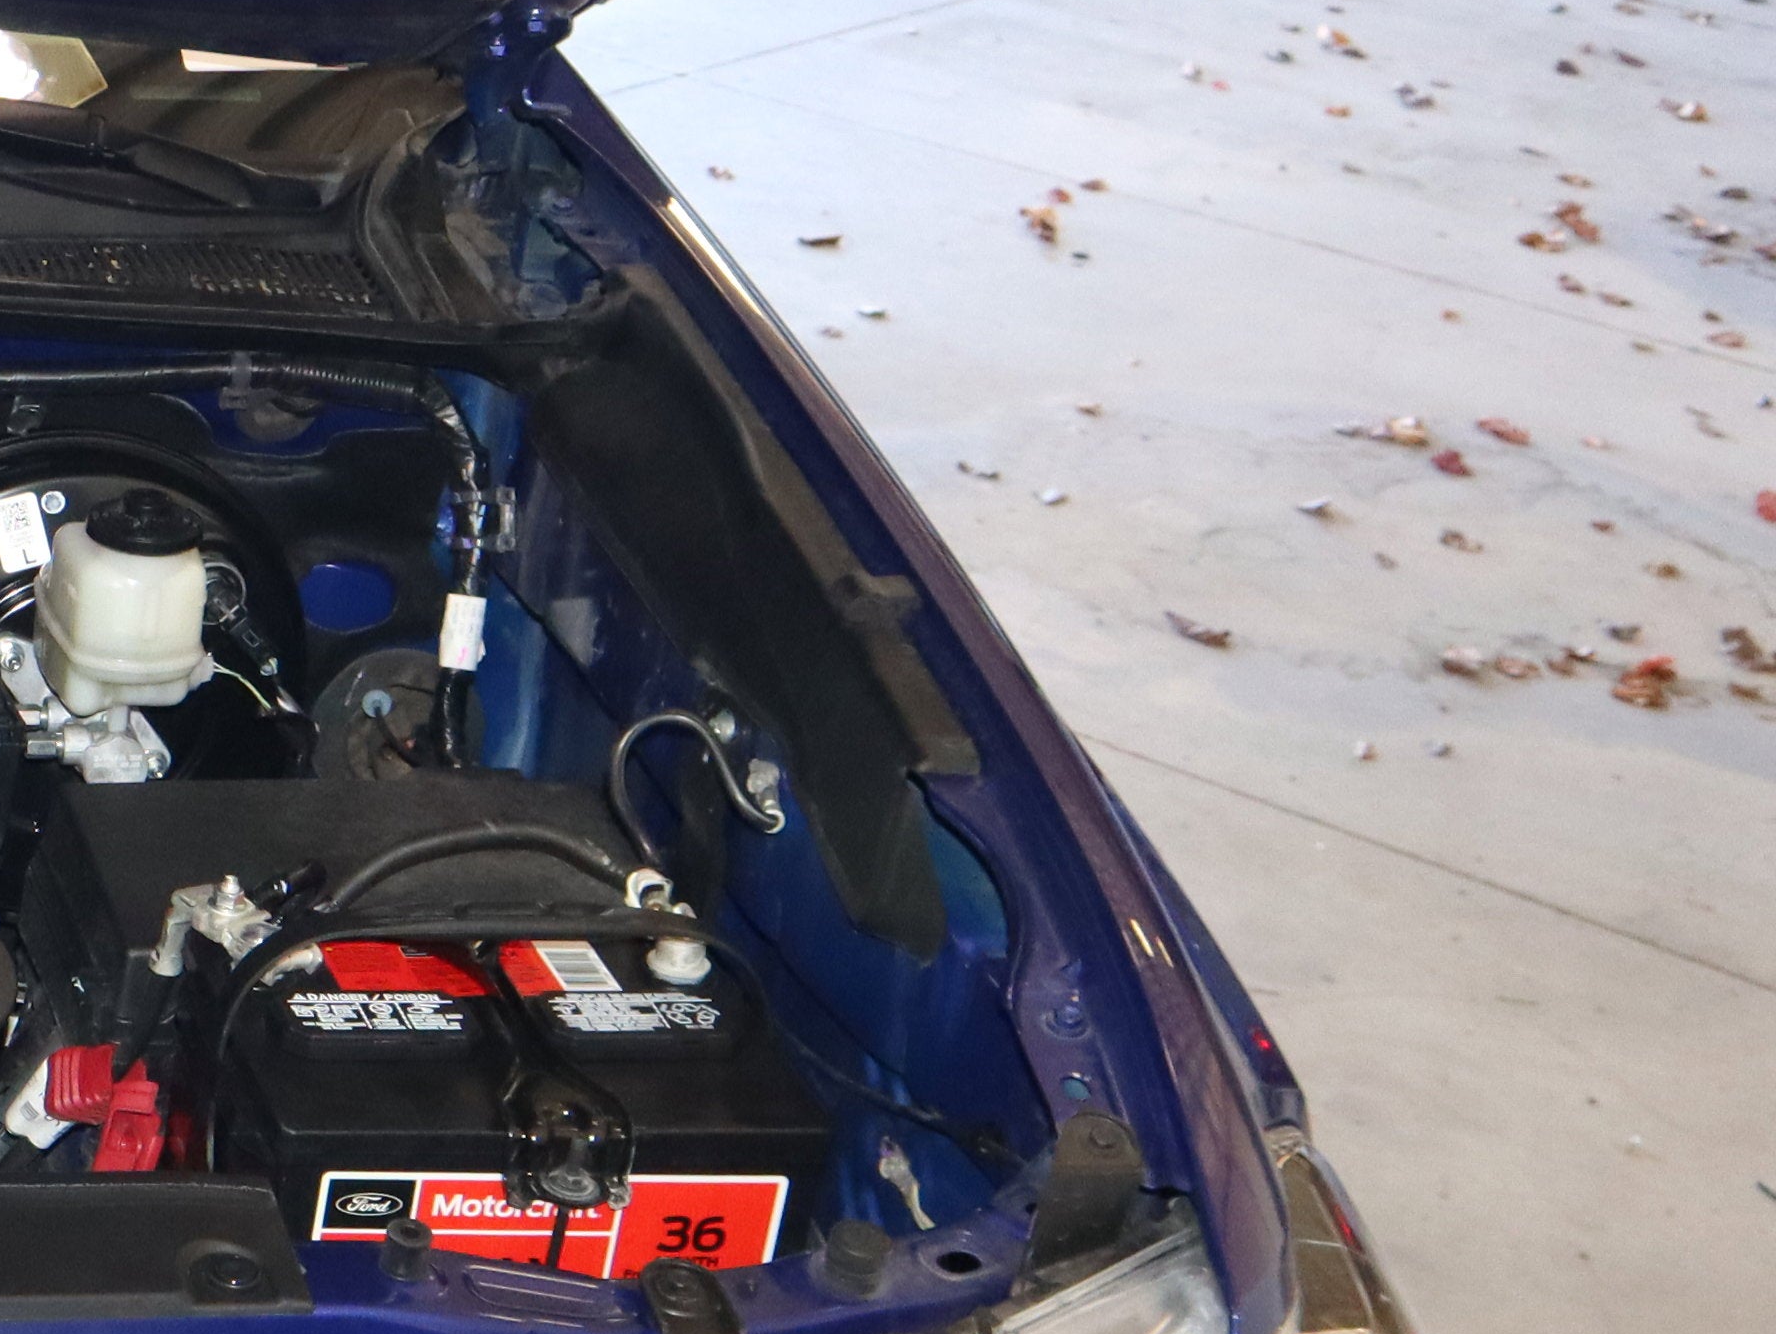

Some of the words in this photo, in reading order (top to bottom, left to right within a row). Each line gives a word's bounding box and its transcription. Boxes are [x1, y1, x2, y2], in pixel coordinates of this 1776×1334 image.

[22, 549, 37, 564] L
[306, 993, 369, 1002] DANGER
[383, 993, 440, 1002] POISON
[346, 1196, 390, 1214] Ford
[656, 1216, 726, 1253] 36
